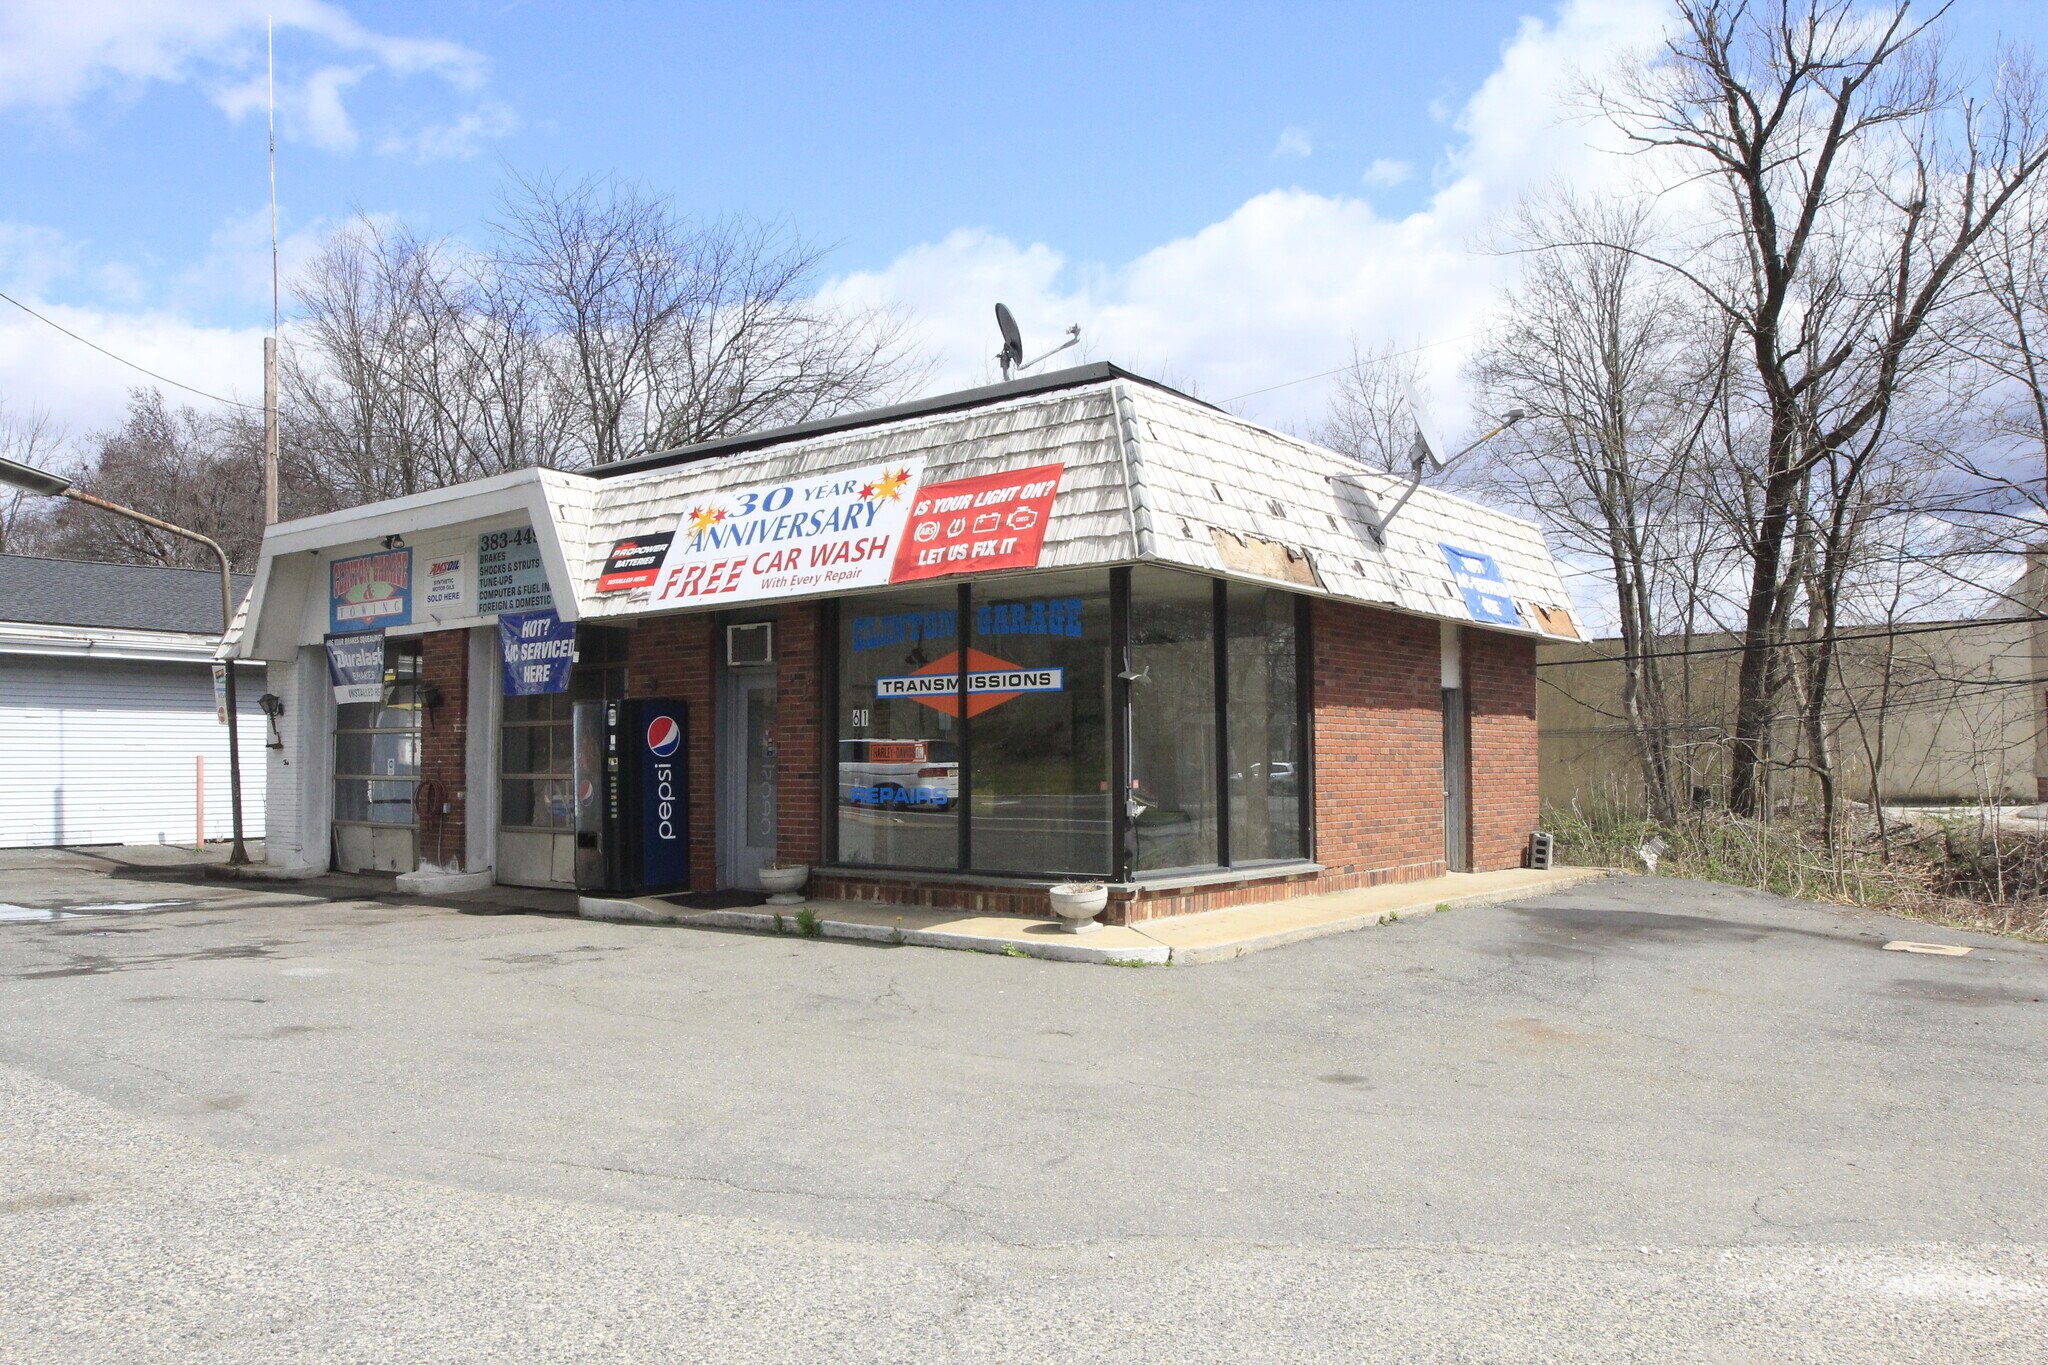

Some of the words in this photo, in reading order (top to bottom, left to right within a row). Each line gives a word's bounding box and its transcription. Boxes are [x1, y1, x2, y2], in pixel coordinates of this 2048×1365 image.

[728, 487, 794, 517] 30
[804, 480, 857, 501] YEAR
[913, 500, 930, 516] IS
[933, 494, 973, 514] YOUR
[973, 486, 1022, 507] LIGHT
[1020, 480, 1056, 499] ON?
[685, 500, 884, 554] ANNIVERSARY
[920, 526, 933, 535] ABS
[480, 552, 506, 564] BRAKES
[612, 544, 669, 558] PROPOWER
[918, 548, 945, 565] LET
[947, 544, 968, 560] US
[971, 540, 998, 558] FIX
[1000, 537, 1017, 554] IT
[430, 560, 459, 576] AMSOIL
[480, 564, 506, 576] SHOCKS
[508, 564, 512, 572] &
[514, 559, 540, 570] STRUTS
[614, 556, 656, 568] BATTERIES
[658, 555, 748, 600] FREE
[752, 548, 802, 574] CAR
[810, 535, 890, 567] WASH
[480, 575, 512, 588] TUNE-UPS
[761, 574, 786, 589] With
[791, 572, 822, 586] Every
[824, 567, 862, 583] Repair
[364, 584, 374, 599] &
[427, 593, 442, 603] SOLD
[444, 592, 460, 600] HERE
[480, 587, 515, 600] COMPUTER
[524, 584, 540, 594] FUEL
[542, 583, 551, 592] IN
[340, 601, 400, 618] TOWING
[480, 600, 507, 612] FOREIGN
[516, 595, 551, 608] DOMESTIC
[977, 599, 1082, 638] GARAGE
[522, 619, 550, 638] HOT?
[333, 647, 383, 668] Duralast
[521, 639, 575, 661] SERVICED
[353, 671, 376, 680] BRAKES
[524, 664, 551, 682] HERE
[883, 673, 1050, 693] TRANSMISSIONS
[853, 710, 868, 726] 61
[655, 764, 676, 839] pepsi
[851, 787, 948, 805] REPAIRS
